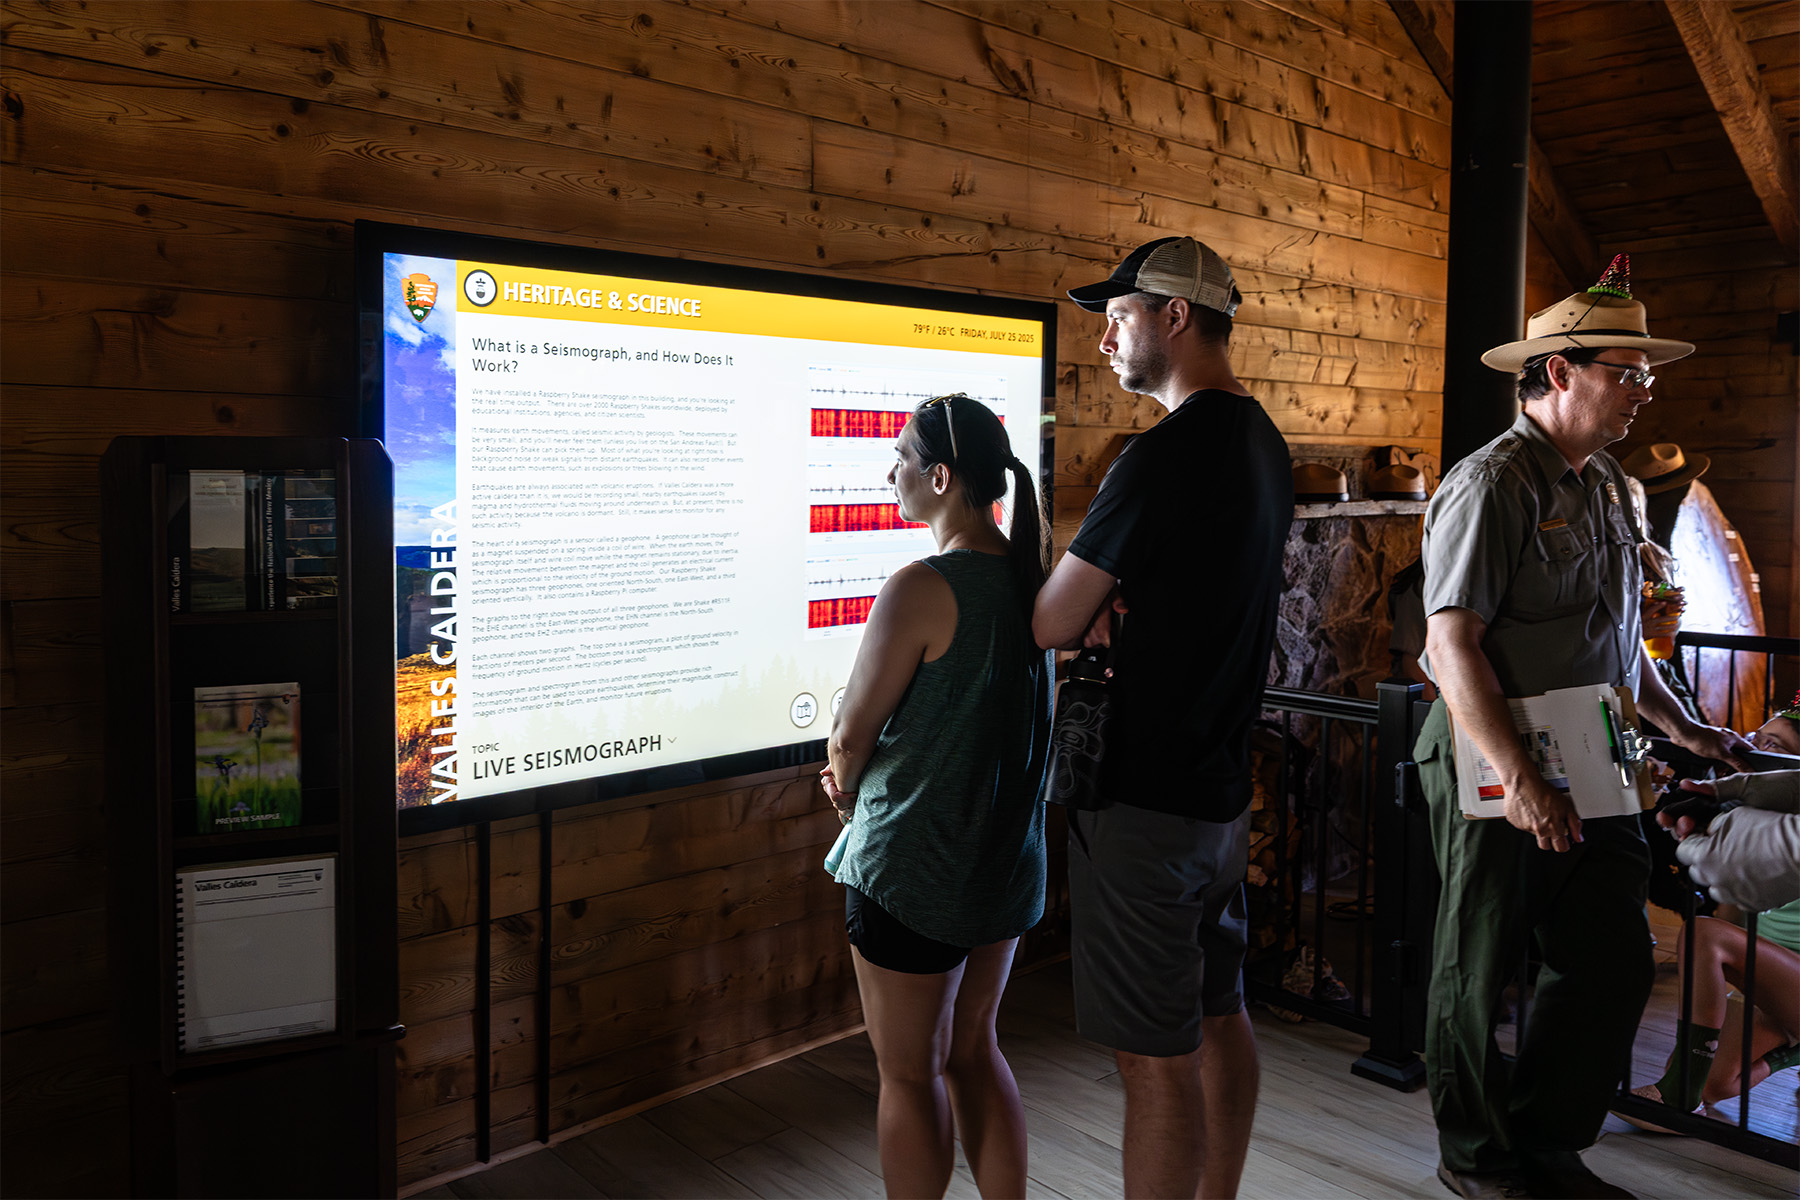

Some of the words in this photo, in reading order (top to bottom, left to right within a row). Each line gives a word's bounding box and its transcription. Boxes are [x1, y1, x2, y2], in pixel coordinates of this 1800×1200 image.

[503, 281, 602, 309] HERITAGE
[607, 291, 623, 311] &
[627, 293, 702, 317] SCIENCE
[913, 324, 930, 334] 79°F
[938, 326, 955, 337] 26°C
[960, 327, 988, 340] FRIDAY,
[989, 330, 1006, 341] JULY
[1007, 332, 1017, 342] 25
[1018, 333, 1035, 343] 2025
[472, 337, 511, 352] What
[515, 340, 525, 353] is
[530, 344, 538, 354] a
[543, 343, 632, 362] Seismograph,
[635, 349, 658, 361] and
[662, 351, 690, 363] How
[694, 352, 722, 365] Does
[725, 353, 733, 366] It
[472, 358, 518, 373] Work?
[503, 388, 531, 396] installed
[538, 390, 569, 400] Raspberry
[591, 392, 629, 402] seismograph
[706, 397, 728, 405] looking
[471, 406, 511, 414] educational
[591, 464, 623, 472] explosions
[648, 464, 671, 472] blowing
[471, 483, 513, 492] Earthquakes
[527, 483, 549, 491] always
[170, 556, 181, 587] Caldera
[471, 568, 484, 576] The
[486, 567, 511, 575] relative
[513, 565, 548, 574] movement
[549, 564, 576, 572] between
[591, 562, 614, 571] magnet
[651, 558, 679, 568] generates
[431, 499, 457, 665] CALDERA
[171, 588, 181, 612] Valles
[471, 625, 484, 633] The
[501, 621, 527, 630] channel
[639, 611, 662, 619] channel
[471, 660, 501, 670] fractions
[512, 657, 534, 666] meters
[575, 652, 587, 660] The
[588, 650, 610, 658] bottom
[674, 642, 691, 650] which
[692, 640, 709, 648] shows
[471, 696, 512, 707] information
[514, 694, 528, 702] that
[552, 690, 567, 698] used
[575, 686, 595, 695] locate
[636, 678, 666, 688] determine
[713, 670, 738, 679] construct
[472, 690, 484, 698] The
[486, 685, 525, 698] seismogram
[527, 684, 540, 692] and
[541, 679, 580, 692] spectrogram
[582, 677, 597, 686] from
[598, 676, 609, 684] this
[610, 674, 622, 682] and
[623, 673, 639, 681] other
[641, 668, 679, 680] seismographs
[679, 666, 700, 676] provide
[431, 677, 457, 805] VALLES
[472, 742, 500, 754] TOPIC
[473, 756, 516, 780] LIVE
[523, 734, 662, 772] SEISMOGRAPH
[215, 815, 249, 825] PREVIEW
[250, 811, 280, 822] SAMPLE
[195, 882, 221, 892] Valles
[223, 879, 258, 889] Caldera
